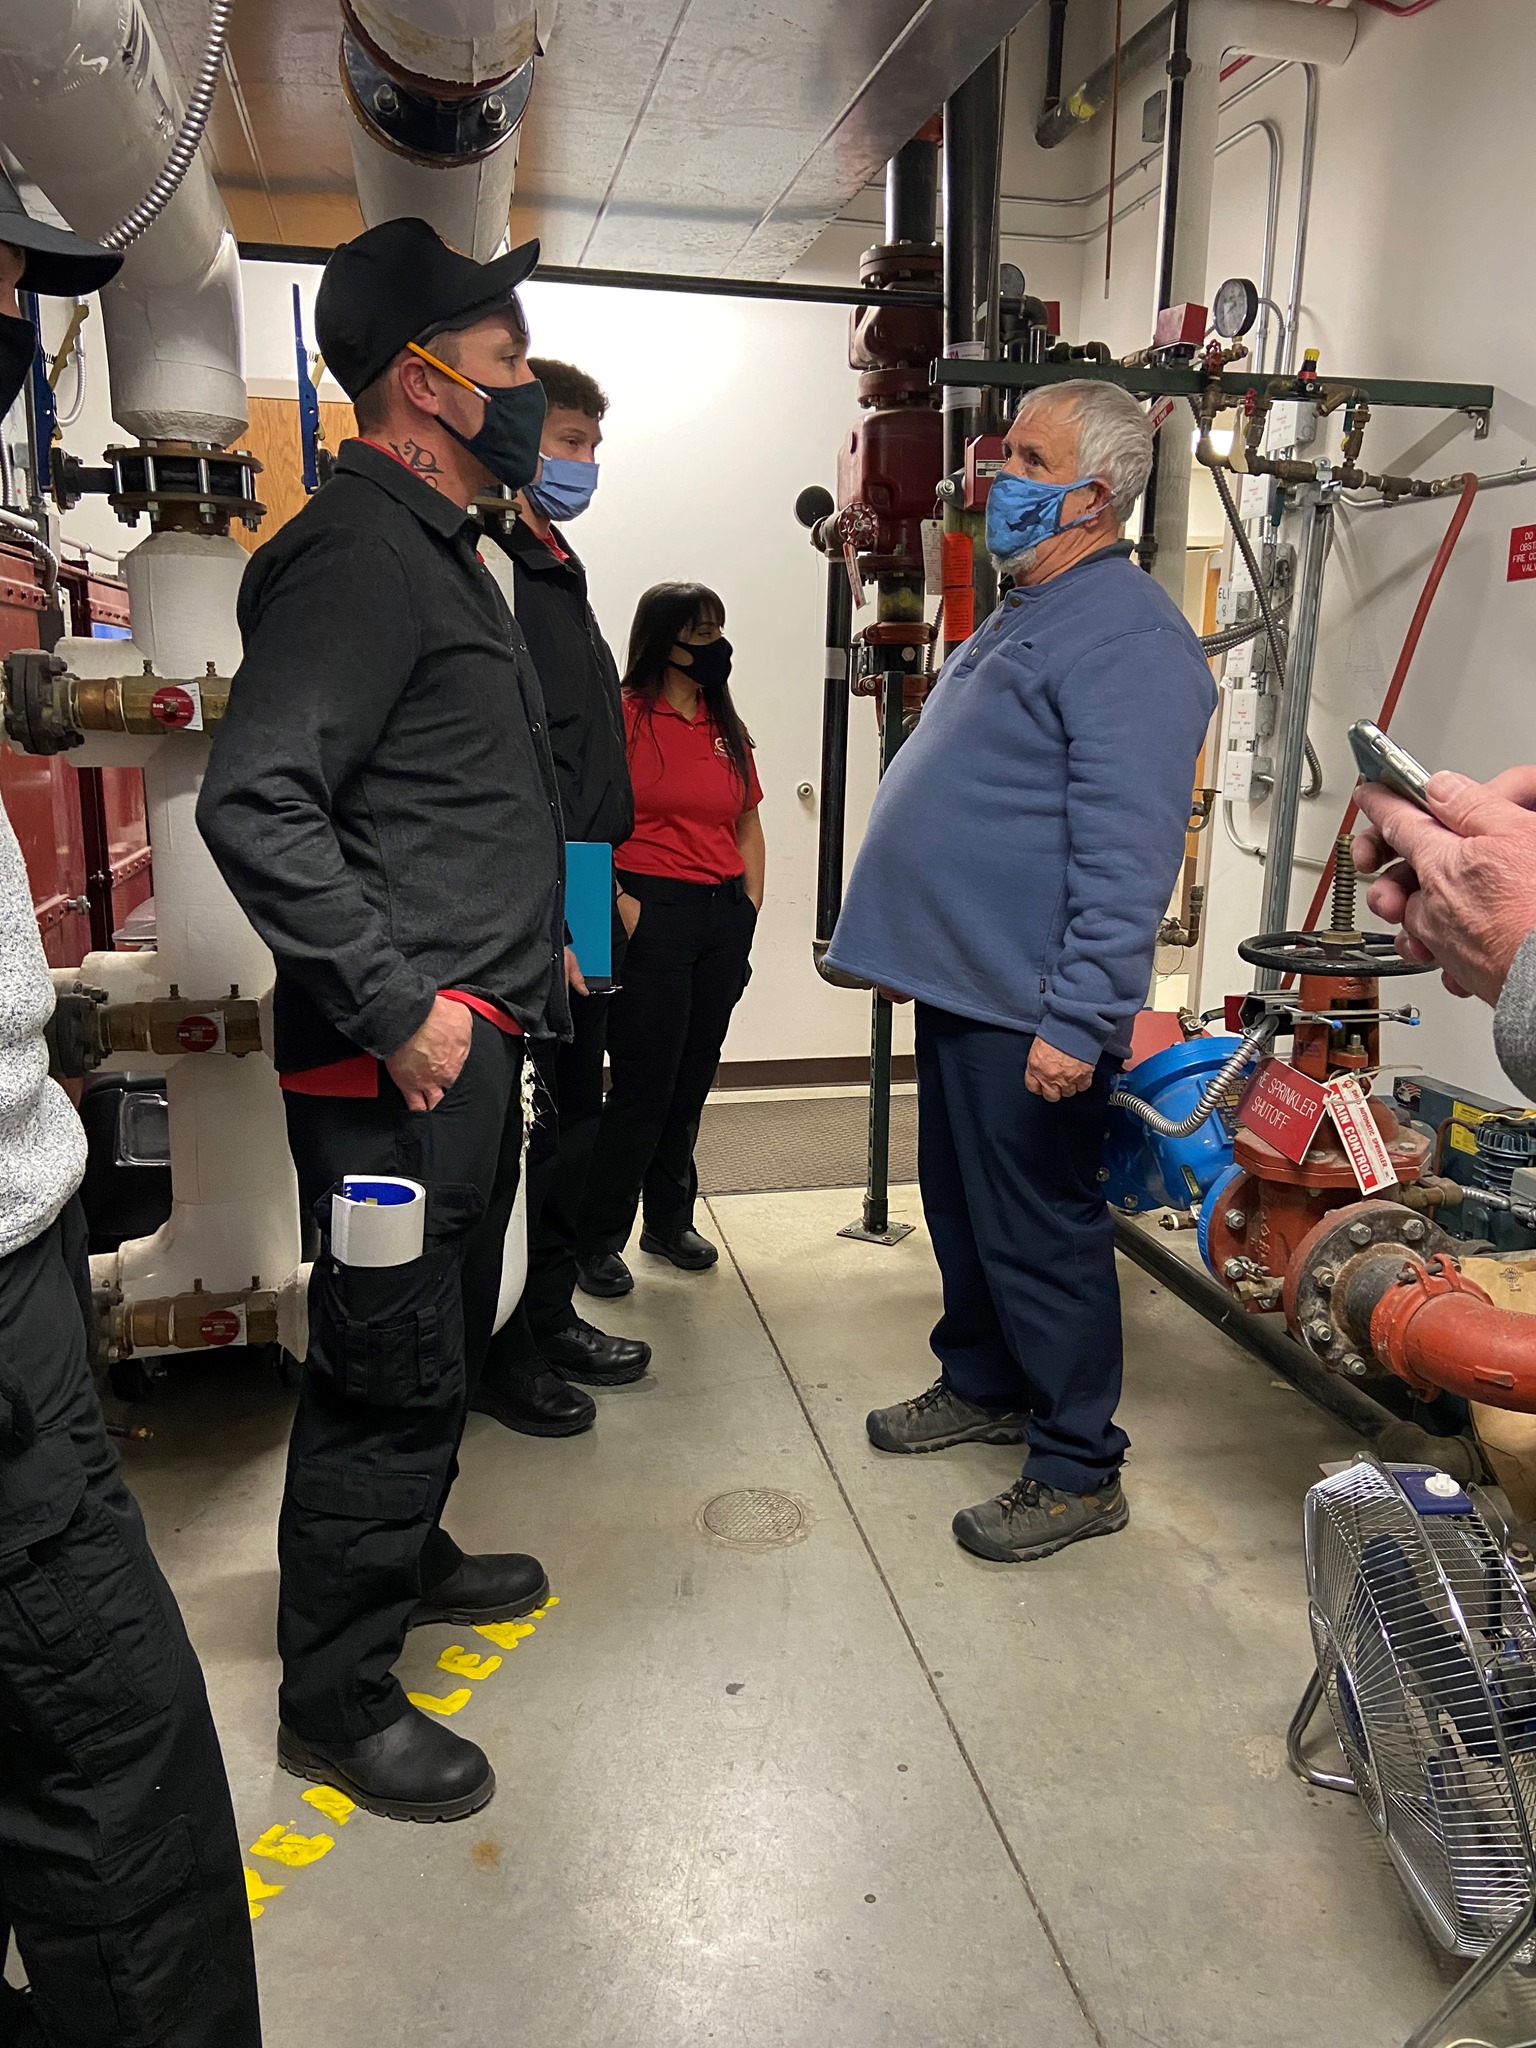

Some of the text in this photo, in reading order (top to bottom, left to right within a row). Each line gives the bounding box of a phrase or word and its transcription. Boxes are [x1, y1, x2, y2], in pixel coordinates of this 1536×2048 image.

[1519, 541, 1536, 552] OBST
[1524, 531, 1534, 541] DO
[1512, 553, 1526, 563] FIRE
[1251, 1095, 1291, 1130] SHUTOFF
[1267, 1077, 1318, 1120] SPRINKLER
[1344, 1126, 1373, 1180] CONTROL
[1358, 1106, 1375, 1136] AUTOMATIC
[1371, 1137, 1388, 1168] SPRINKLER
